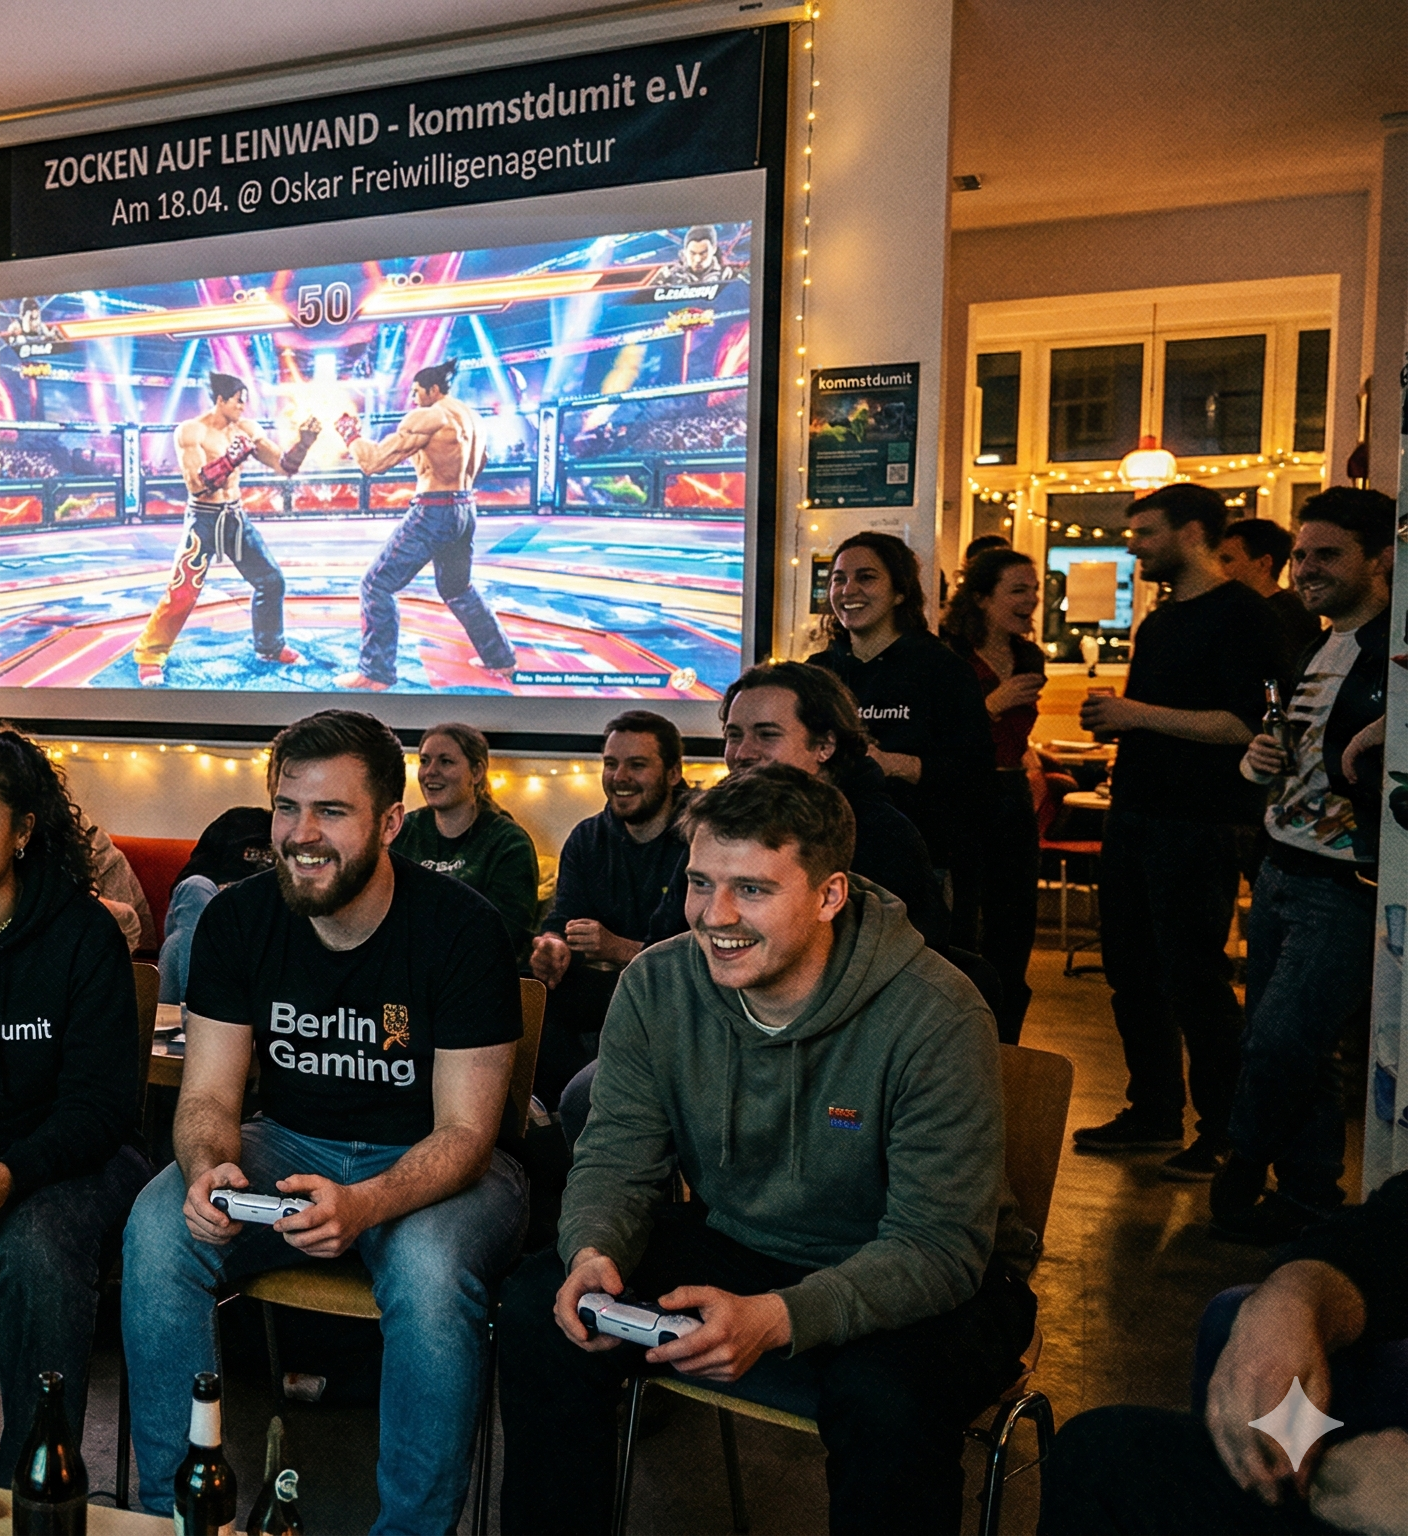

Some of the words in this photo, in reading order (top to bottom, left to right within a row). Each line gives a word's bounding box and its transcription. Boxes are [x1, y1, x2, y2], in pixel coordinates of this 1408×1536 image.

[45, 147, 149, 190] ZOCKEN
[157, 134, 213, 174] AUF
[221, 113, 380, 164] LEINWAND
[387, 124, 399, 132] -
[408, 73, 637, 138] kommstdumit
[646, 62, 708, 103] e.V.
[111, 198, 150, 226] Am
[157, 185, 230, 221] 18.04.
[236, 180, 263, 213] @
[269, 174, 344, 206] Oskar
[352, 133, 617, 197] Freiwilligenagentur
[297, 281, 352, 328] 50
[817, 372, 913, 390] kommstdumit
[857, 704, 910, 719] tdumit
[269, 1001, 377, 1044] Berlin
[268, 1039, 416, 1087] Gaming
